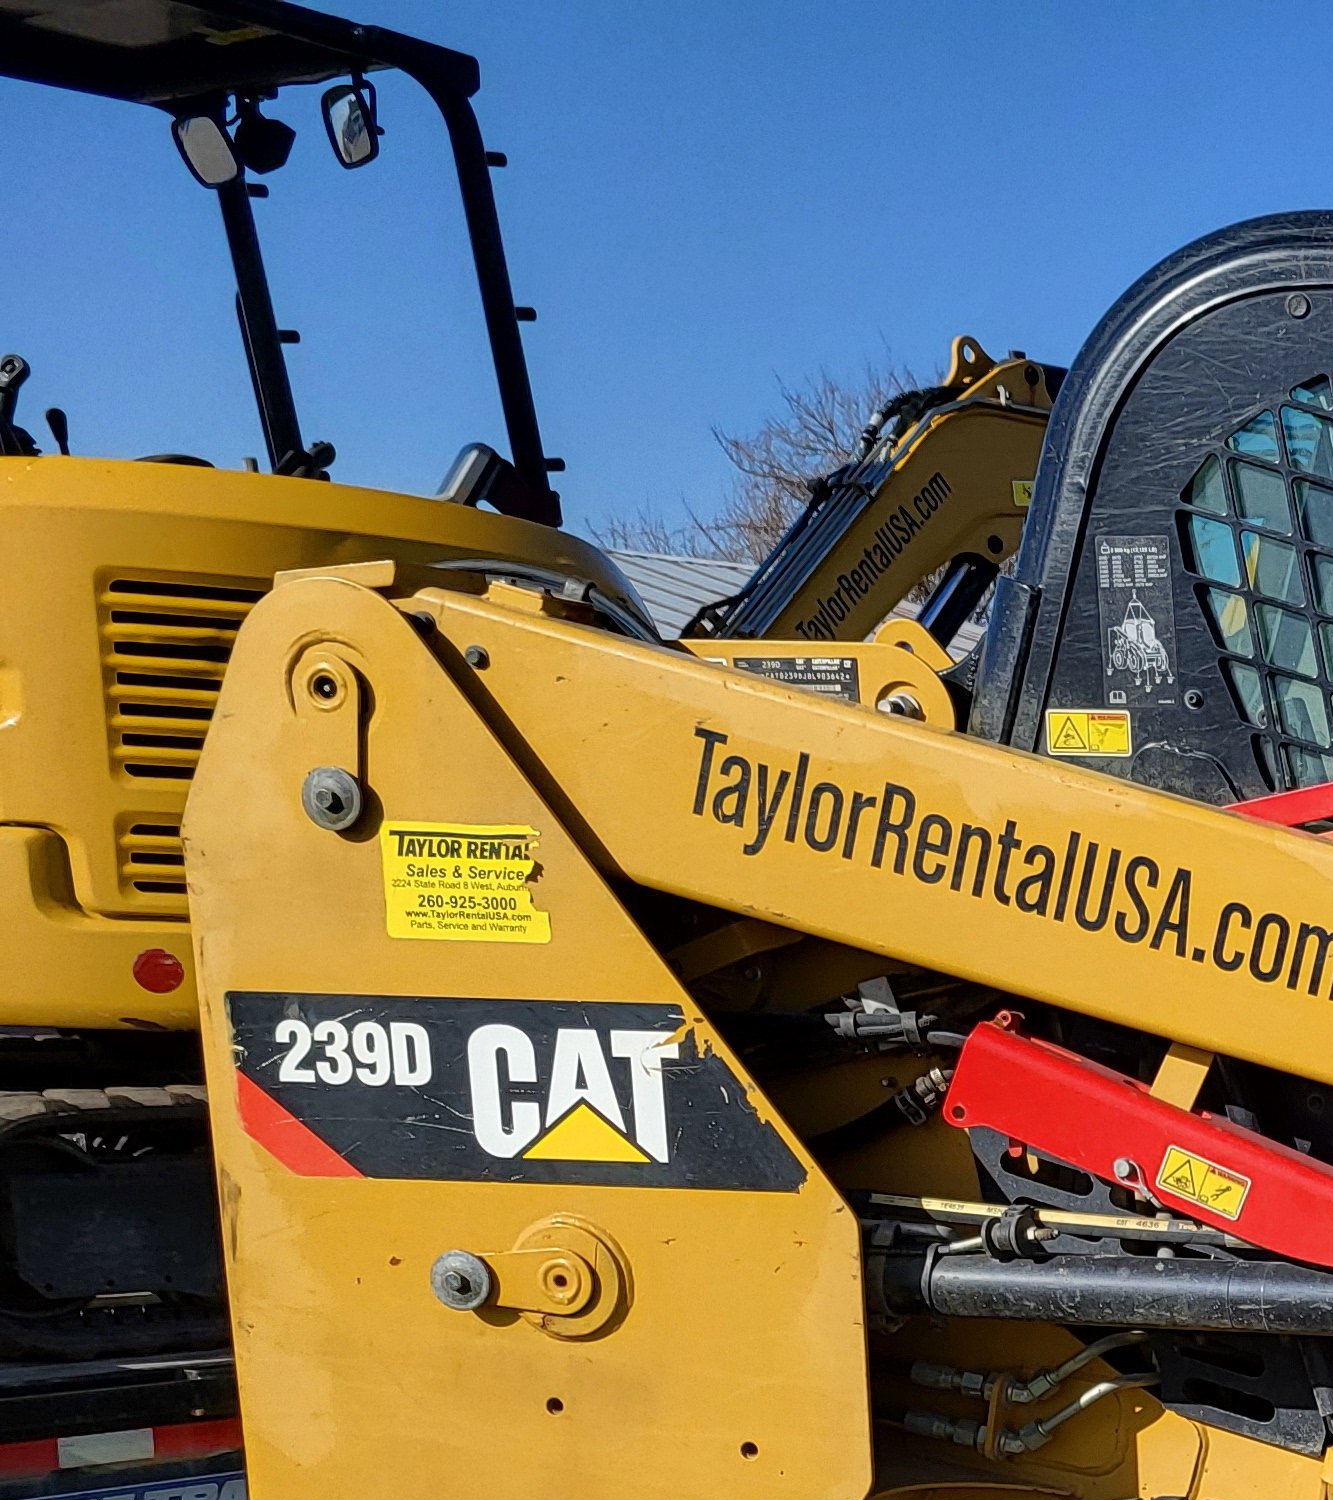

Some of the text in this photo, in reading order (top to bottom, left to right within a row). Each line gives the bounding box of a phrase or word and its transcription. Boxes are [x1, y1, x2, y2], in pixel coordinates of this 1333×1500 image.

[391, 831, 462, 859] TAYLOR
[406, 863, 525, 881] Sales & Service
[414, 879, 436, 889] State
[438, 880, 461, 890] Road
[418, 894, 517, 911] 260-925-3000
[405, 909, 532, 922] www.TaylorRentalUSA.com
[410, 920, 527, 934] Parts, Service and Warranty
[275, 1020, 433, 1087] 239D
[466, 1024, 679, 1164] CAT
